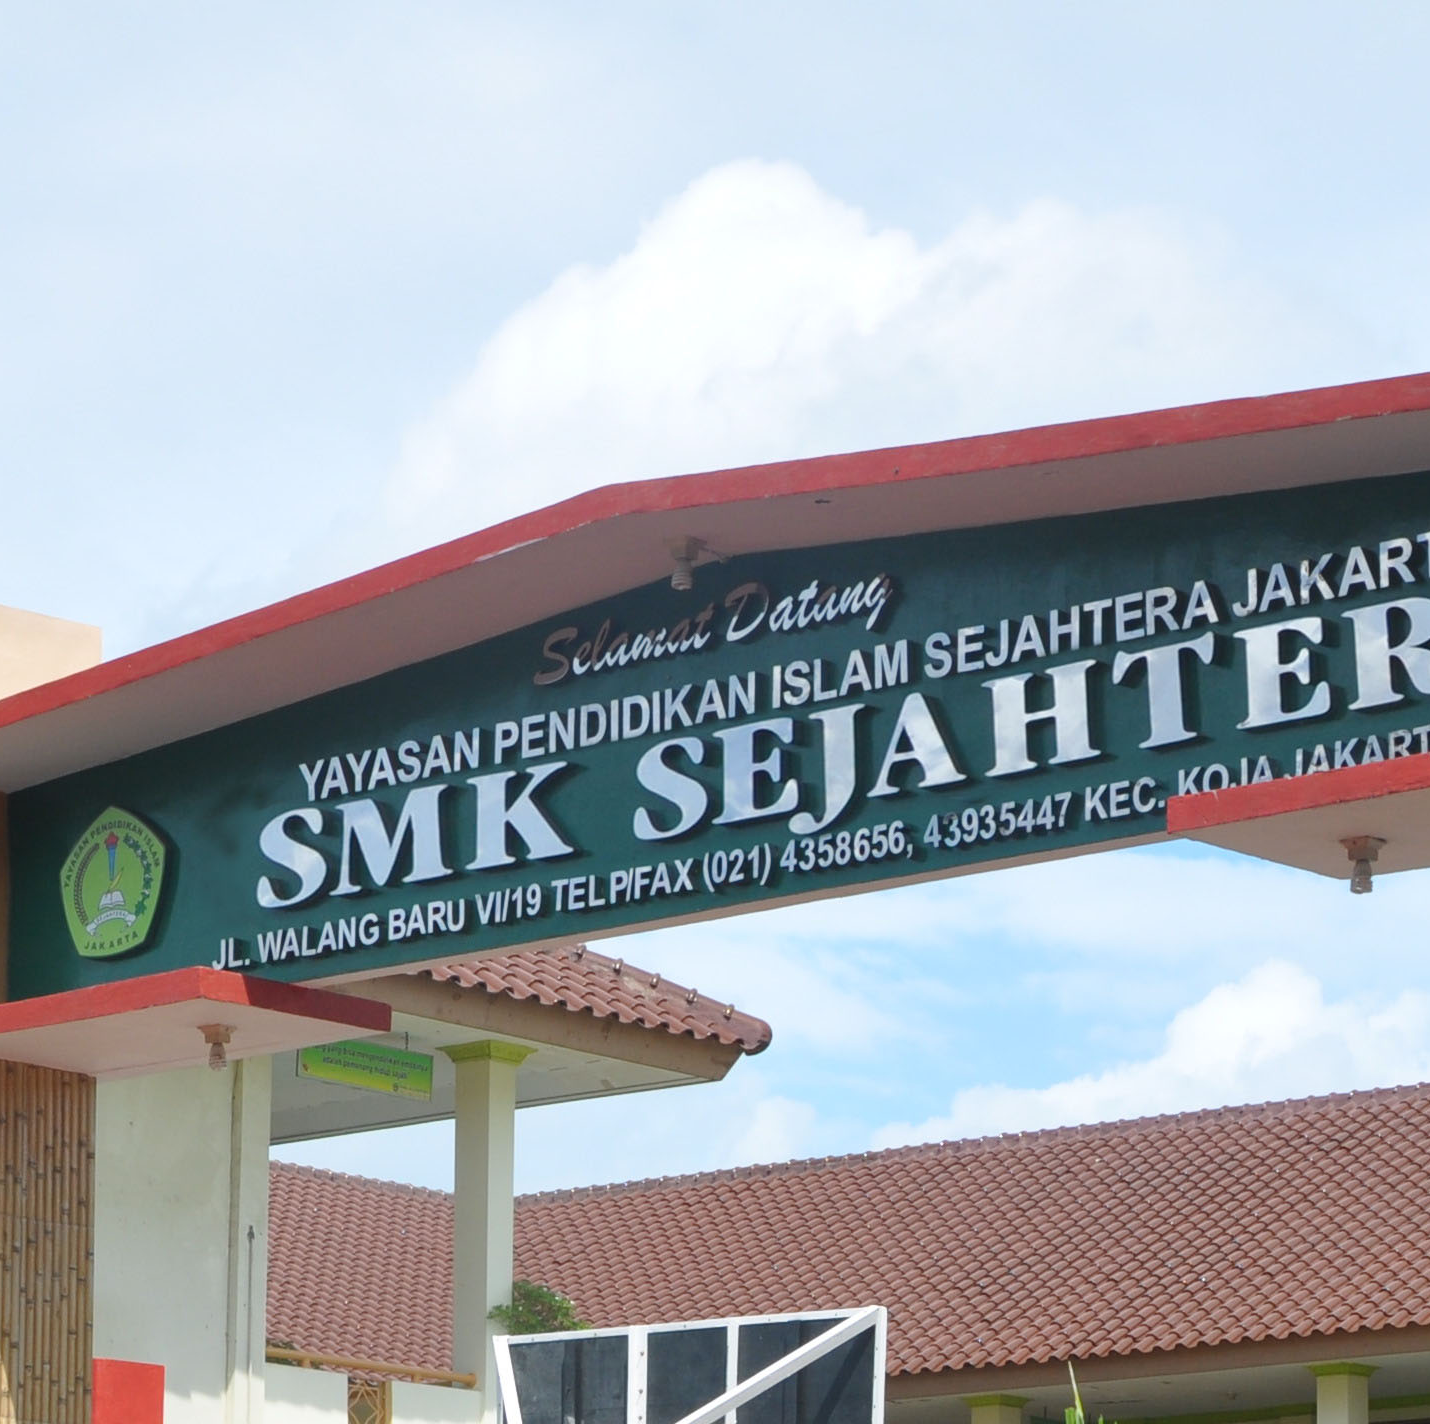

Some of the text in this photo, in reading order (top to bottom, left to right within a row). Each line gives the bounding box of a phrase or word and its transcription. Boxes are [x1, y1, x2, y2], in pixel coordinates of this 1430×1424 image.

[299, 727, 480, 802] YAYASAN
[493, 670, 757, 765] PENDIDIKAN
[771, 639, 909, 710] ISLAM
[924, 580, 1219, 679] SEJAHTERA
[534, 573, 893, 686] Selamat Datang
[63, 819, 161, 889] YAYASAN PENDIDIKAN ISLAM
[212, 938, 251, 970] JL.
[257, 912, 380, 965] WALANG
[387, 898, 467, 942] BARU
[475, 883, 542, 926] VI/19
[702, 842, 772, 893] (021)
[779, 819, 914, 873] 4358656,
[923, 791, 1072, 849] 43935447
[1084, 776, 1167, 822] KEC.
[256, 760, 574, 909] SMK
[83, 930, 139, 951] JAKARTA
